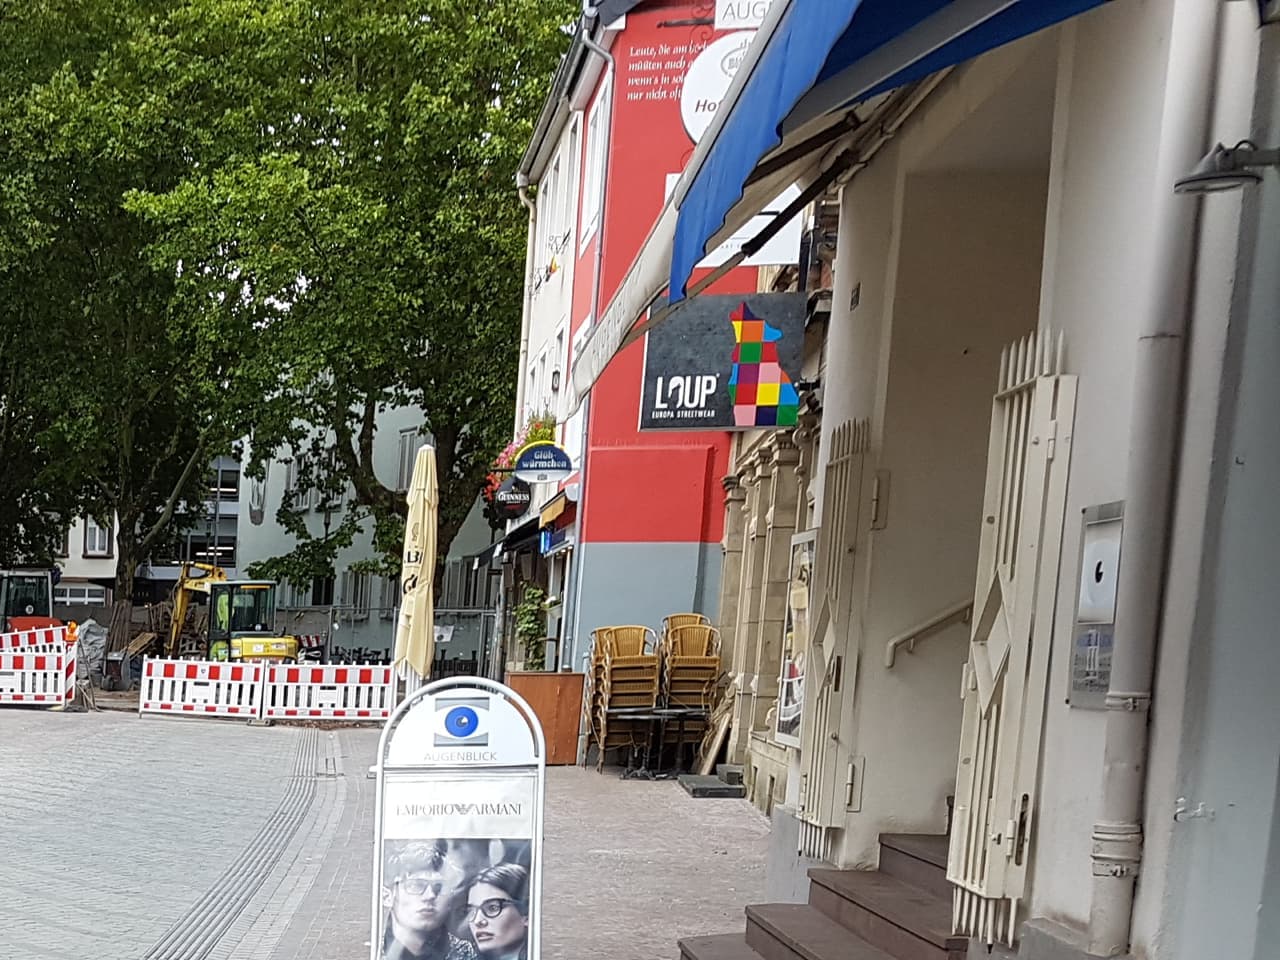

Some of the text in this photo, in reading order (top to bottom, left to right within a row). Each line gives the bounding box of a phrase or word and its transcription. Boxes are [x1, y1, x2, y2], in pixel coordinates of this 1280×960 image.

[629, 46, 657, 59] Leute,
[672, 44, 688, 54] am
[671, 70, 684, 84] sol
[627, 91, 644, 100] nur
[645, 86, 667, 99] nicht
[695, 99, 721, 113] Ho
[655, 375, 717, 409] LOUP
[652, 410, 715, 419] EUROPA STREETWEAR
[498, 493, 530, 502] GUINNESS
[423, 751, 498, 762] AUGENBLICK
[396, 803, 522, 817] EMPORIO ARMANI
